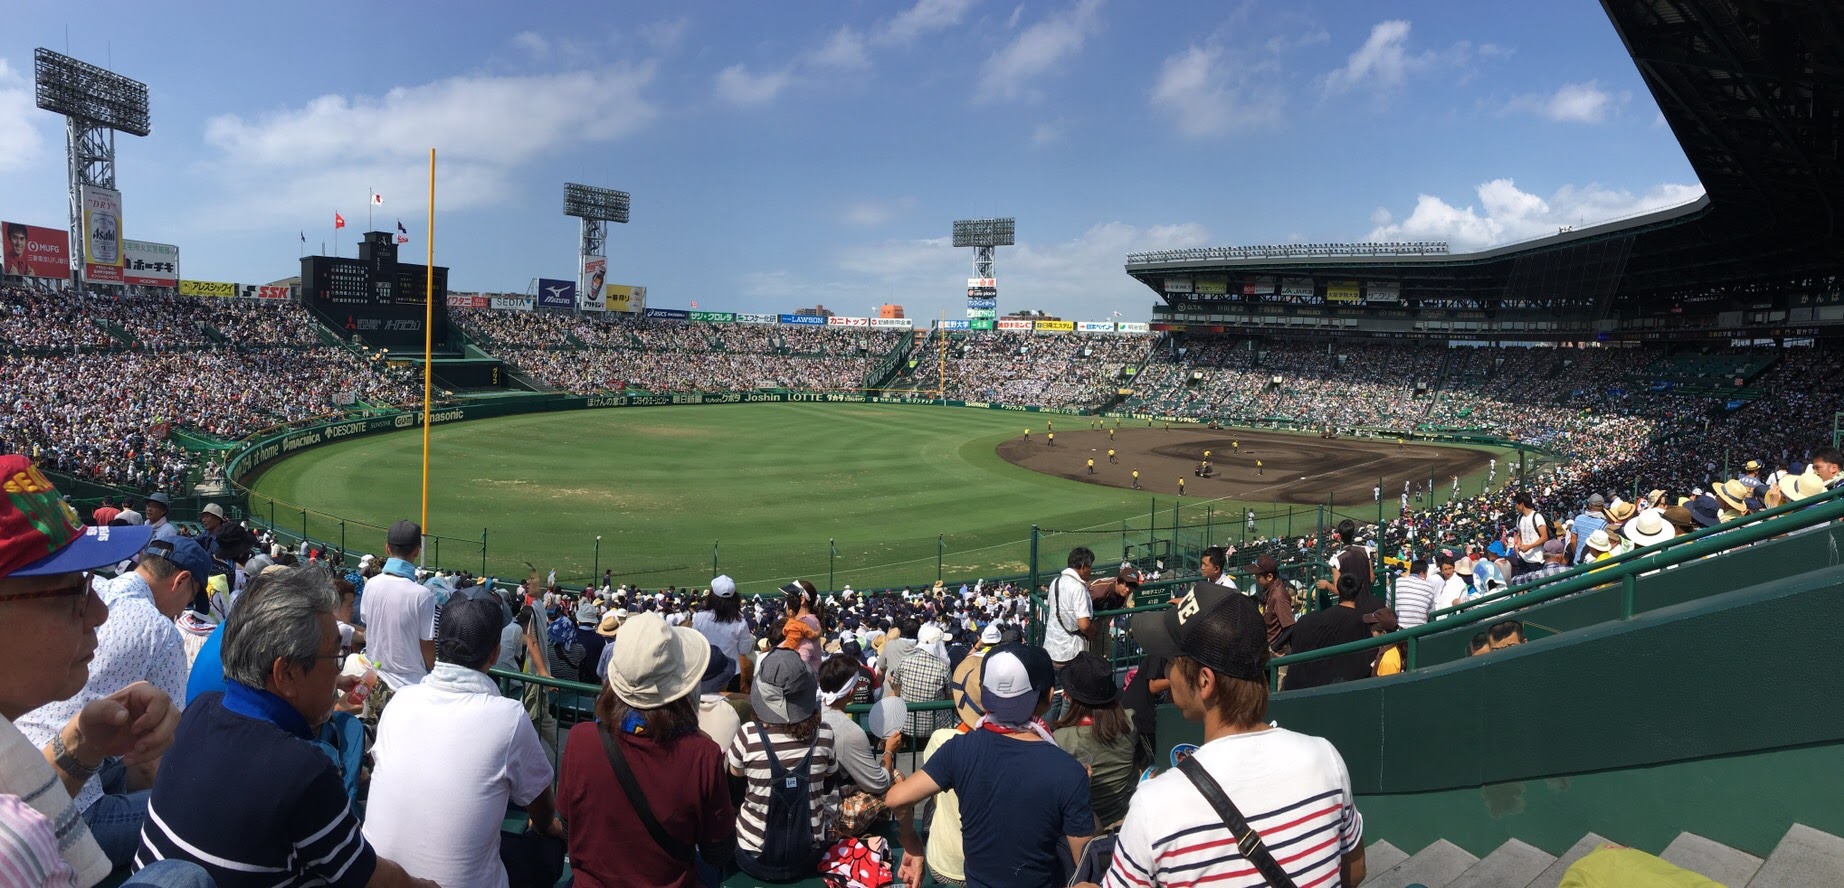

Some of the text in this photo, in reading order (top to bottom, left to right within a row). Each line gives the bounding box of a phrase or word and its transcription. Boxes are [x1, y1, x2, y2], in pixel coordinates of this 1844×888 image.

[92, 227, 115, 242] Asahi
[39, 243, 60, 254] MUFG
[133, 259, 174, 273] ホーチキ
[257, 285, 290, 299] SSK
[496, 297, 526, 308] SEDIA
[791, 316, 824, 324] LAWSON
[829, 317, 868, 326] カニトップ
[672, 394, 703, 404] 朝日新聞
[722, 393, 741, 403] クボタ
[745, 392, 780, 402] Joshin
[788, 393, 823, 402] LOTTE
[417, 408, 464, 424] Pnasonic
[333, 421, 367, 438] DESCENTE
[260, 443, 279, 462] home
